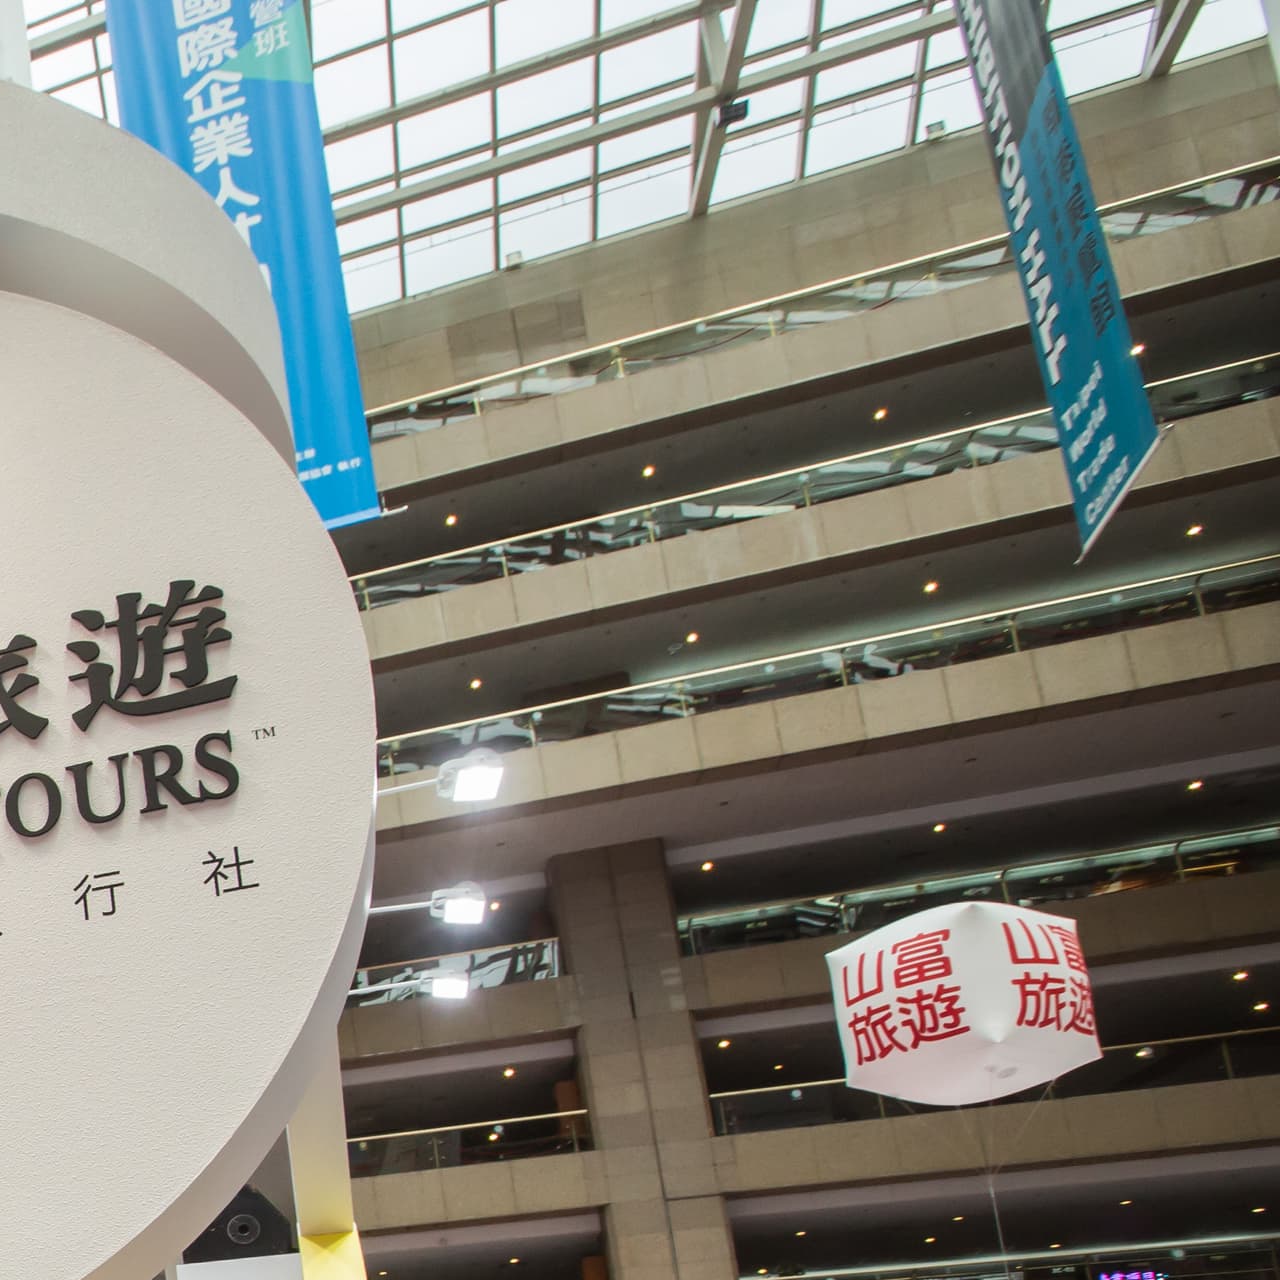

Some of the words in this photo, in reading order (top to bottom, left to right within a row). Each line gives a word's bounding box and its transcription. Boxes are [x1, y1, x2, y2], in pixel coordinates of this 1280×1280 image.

[843, 928, 953, 1007] 山富
[1002, 918, 1088, 975] 山富
[848, 984, 971, 1066] 旅遊
[1011, 972, 1096, 1035] 旅遊
